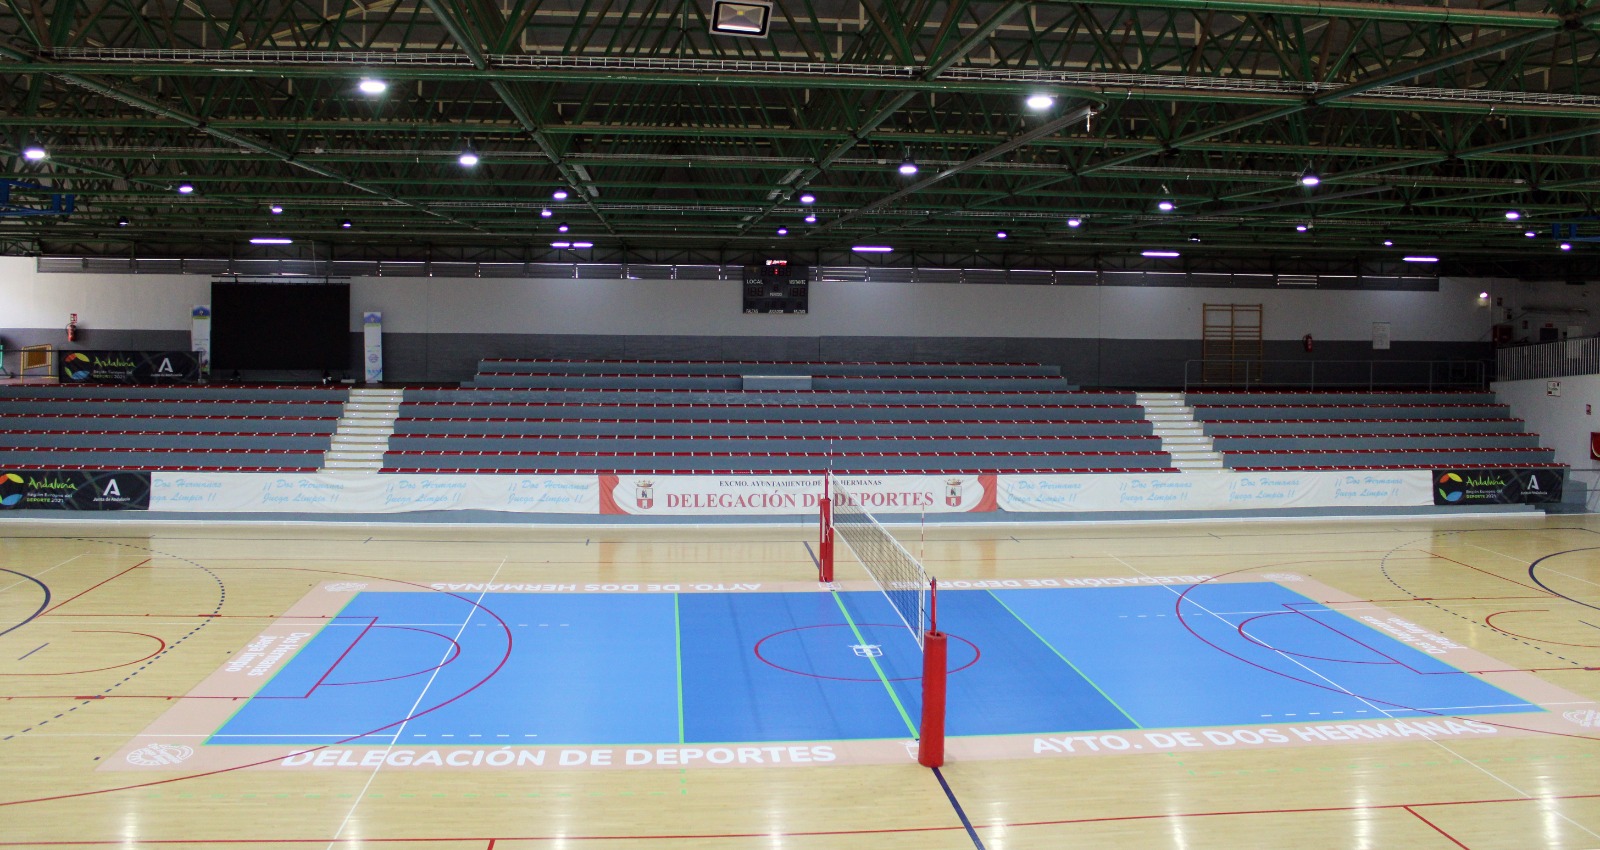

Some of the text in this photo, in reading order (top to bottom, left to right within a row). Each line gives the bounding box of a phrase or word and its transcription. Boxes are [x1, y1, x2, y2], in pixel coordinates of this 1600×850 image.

[751, 480, 811, 488] AYUNTAMIENTO
[666, 490, 796, 508] DELEGACIÓN
[833, 491, 934, 508] DEPORTES
[430, 582, 762, 592] AYTO. DE DOS HERMANAS
[1027, 578, 1061, 587] DE
[1033, 718, 1498, 754] AYTO. DE DOS HERMANAS
[280, 745, 836, 768] DELEGACIÓN DE DEPORTES
